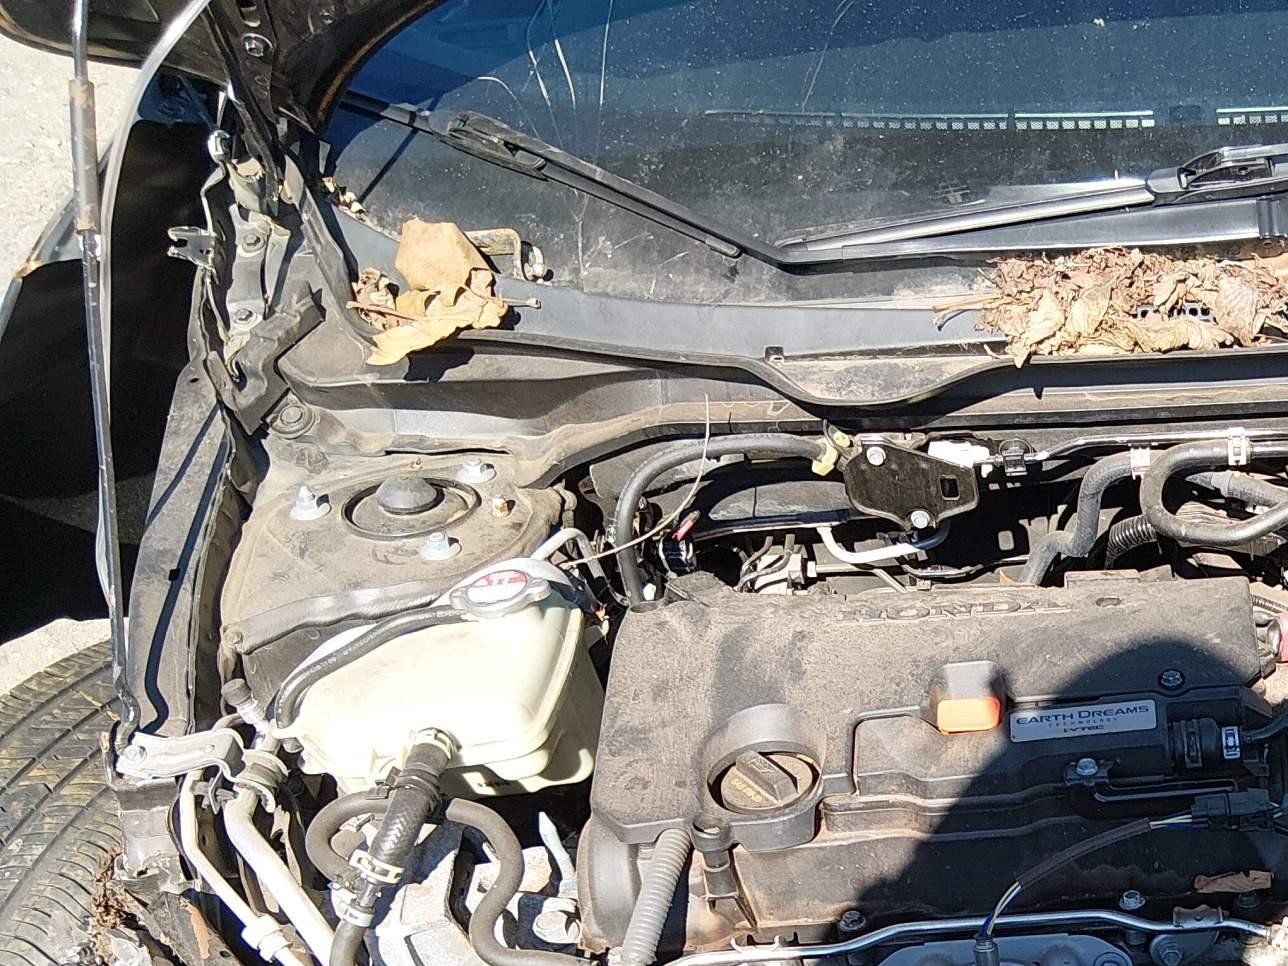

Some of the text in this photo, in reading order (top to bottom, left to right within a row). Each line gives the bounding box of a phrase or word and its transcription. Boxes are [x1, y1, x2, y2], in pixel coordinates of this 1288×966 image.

[837, 602, 1072, 623] HONDA
[1016, 704, 1150, 726] EARTH DREAMS
